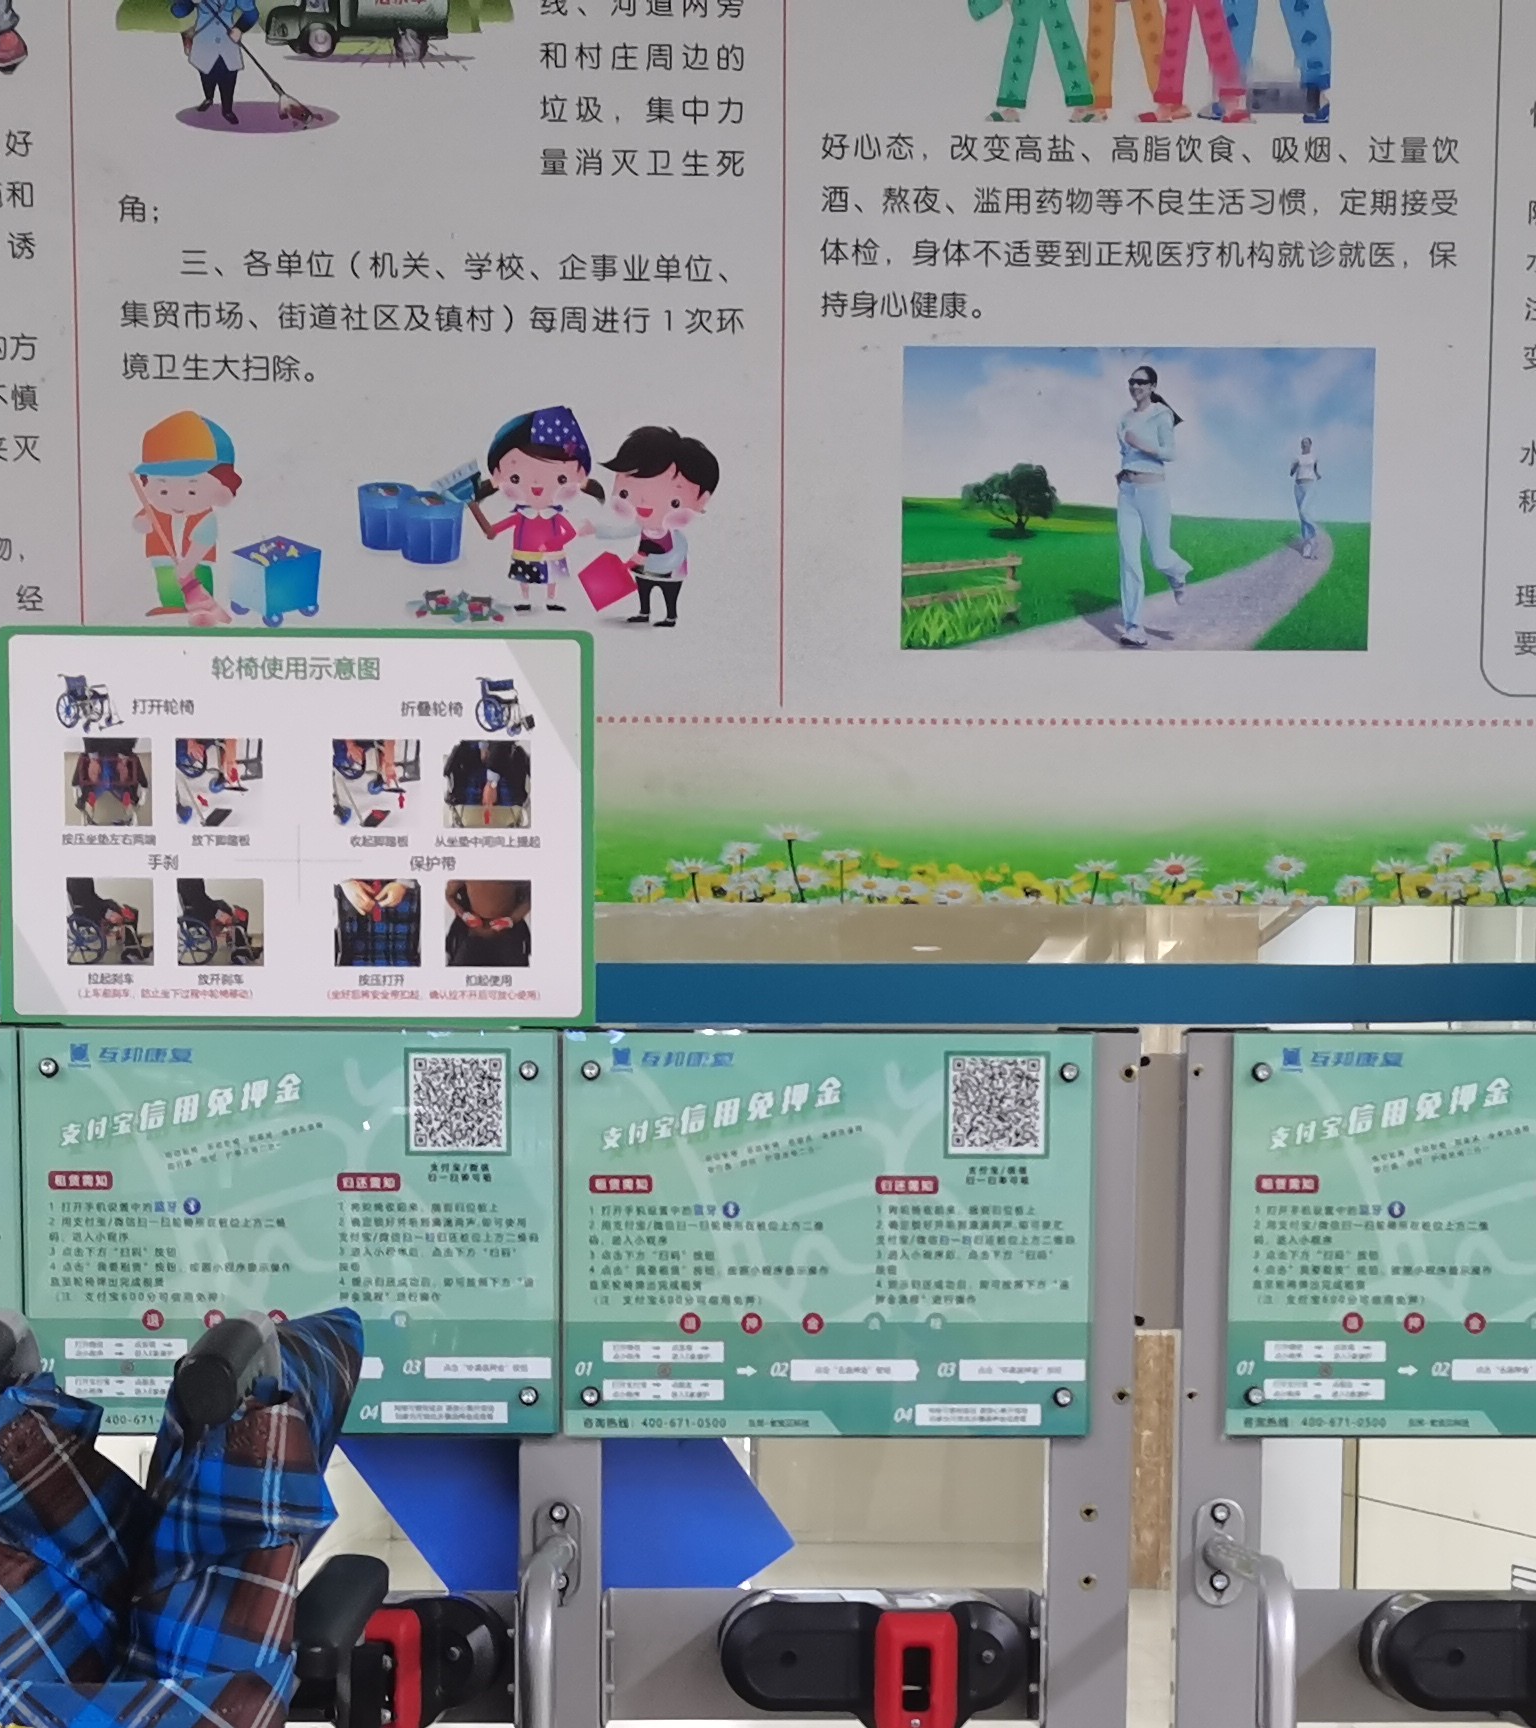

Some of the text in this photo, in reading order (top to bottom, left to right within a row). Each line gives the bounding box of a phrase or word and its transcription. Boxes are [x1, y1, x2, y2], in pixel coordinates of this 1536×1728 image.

[538, 41, 745, 73] 和村庄周边的
[539, 93, 744, 126] 垃圾，集中力
[539, 147, 746, 178] 量消灭卫生死
[117, 193, 159, 225] 角；
[819, 289, 982, 320] 持身心健康。
[121, 351, 315, 383] 境卫生大扫除。
[211, 655, 381, 681] 轮椅使用示意图
[132, 698, 195, 716] 打开轮椅
[400, 700, 464, 719] 折叠轮椅
[148, 854, 179, 870] 手刹
[410, 855, 457, 871] 保护带
[98, 1047, 193, 1063] 互邦康复
[59, 1073, 302, 1147] 支付宝信用免押金
[601, 1077, 843, 1150] 支付宝信用免押金
[1268, 1077, 1513, 1150] 支付宝信用免押金
